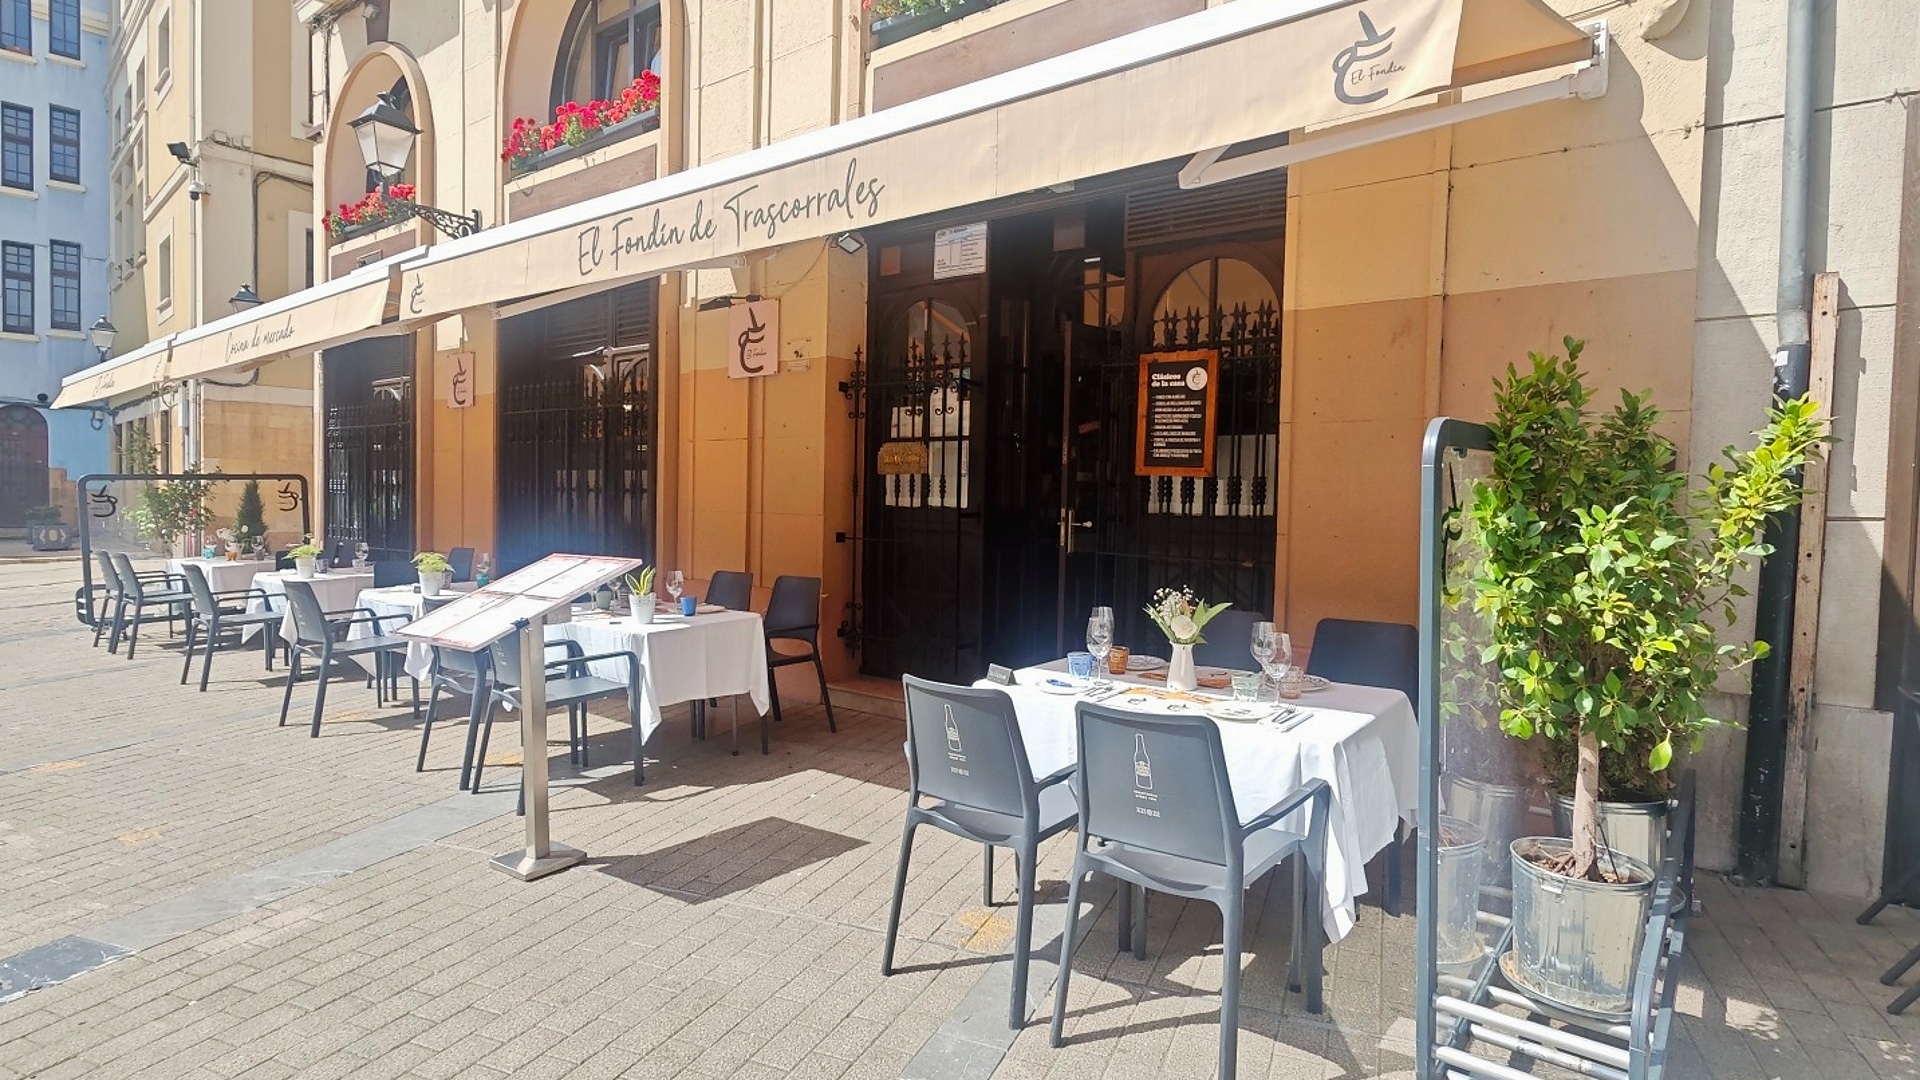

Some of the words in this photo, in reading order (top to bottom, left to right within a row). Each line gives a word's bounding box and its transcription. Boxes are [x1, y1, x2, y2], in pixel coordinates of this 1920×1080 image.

[1351, 69, 1365, 85] El
[577, 226, 604, 277] El
[610, 208, 686, 271] Fondín
[689, 199, 718, 240] de
[723, 157, 886, 248] Trascorrales
[251, 324, 261, 348] de
[263, 315, 295, 344] mercado
